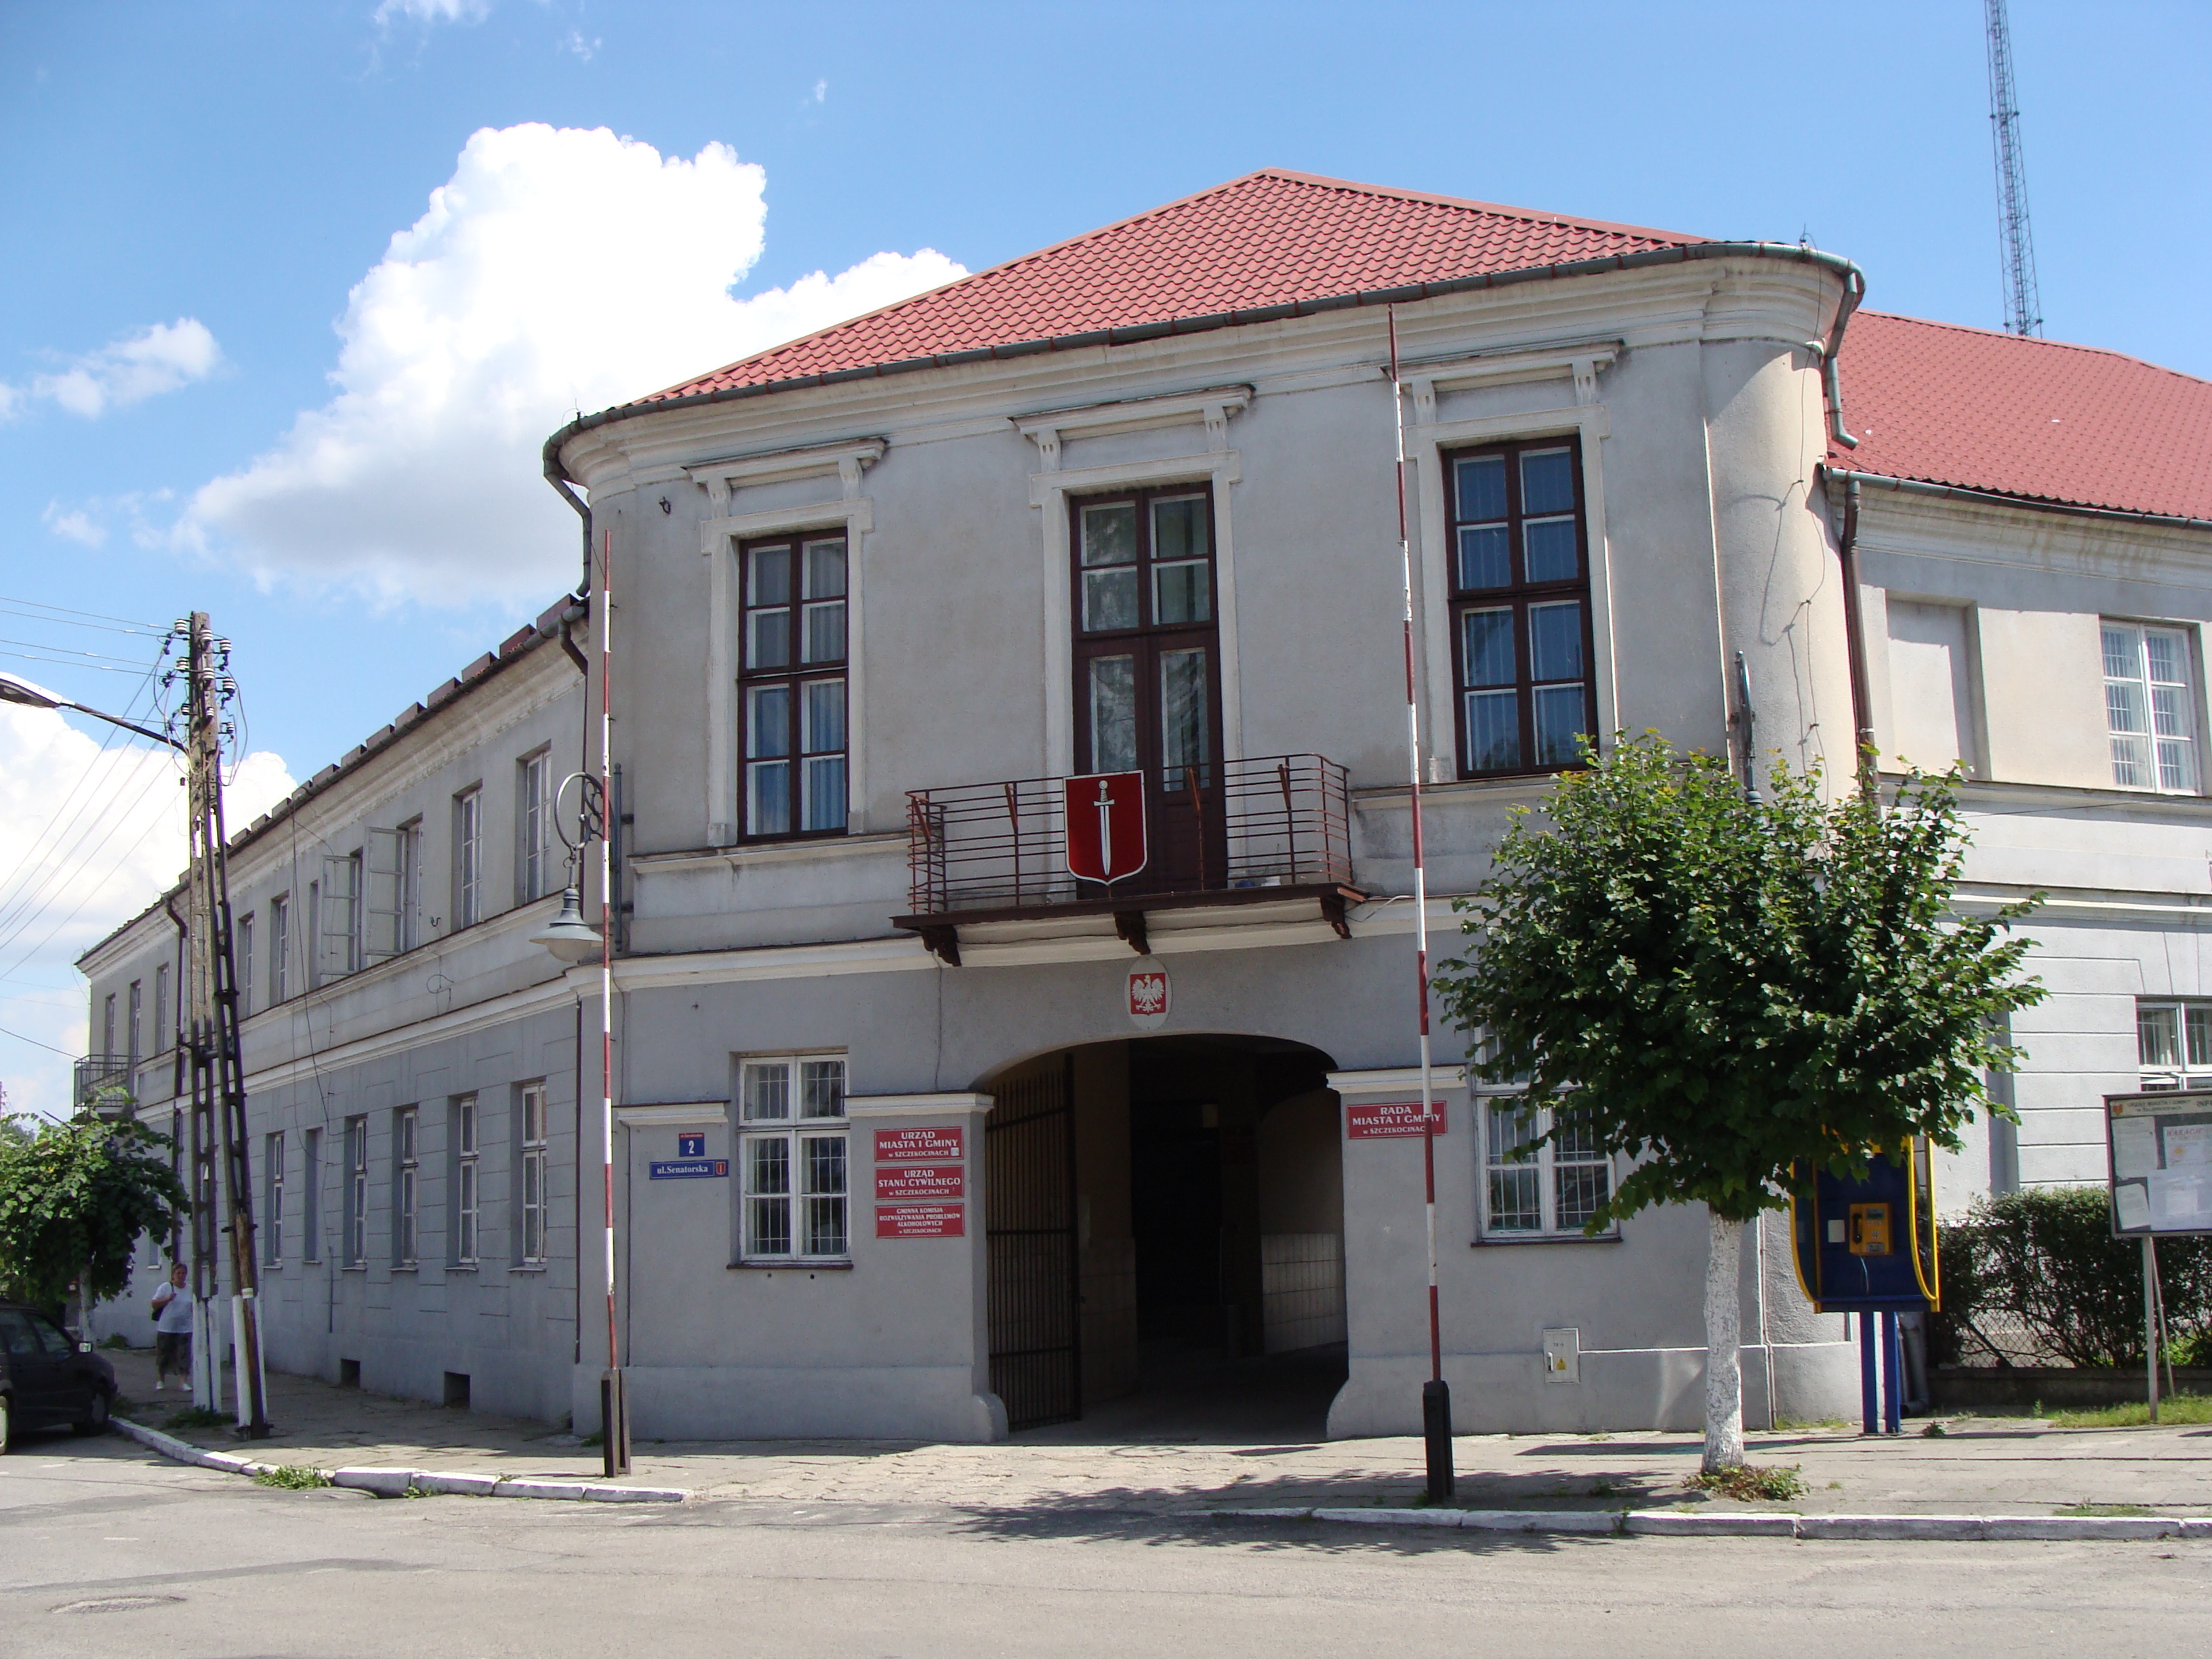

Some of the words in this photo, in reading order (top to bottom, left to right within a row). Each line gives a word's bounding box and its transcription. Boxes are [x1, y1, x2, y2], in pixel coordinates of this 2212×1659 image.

[1380, 1106, 1412, 1115] RADA
[1353, 1116, 1393, 1125] MIASTA
[1370, 1126, 1425, 1134] SZCZEKOCINAC
[901, 1131, 935, 1140] URZĄD
[689, 1140, 695, 1154] 2
[880, 1141, 916, 1149] MIASTA
[925, 1139, 958, 1147] GMINY
[904, 1170, 934, 1179] URZĄD
[878, 1179, 906, 1187] STANU
[909, 1177, 960, 1186] CYWILNEGO
